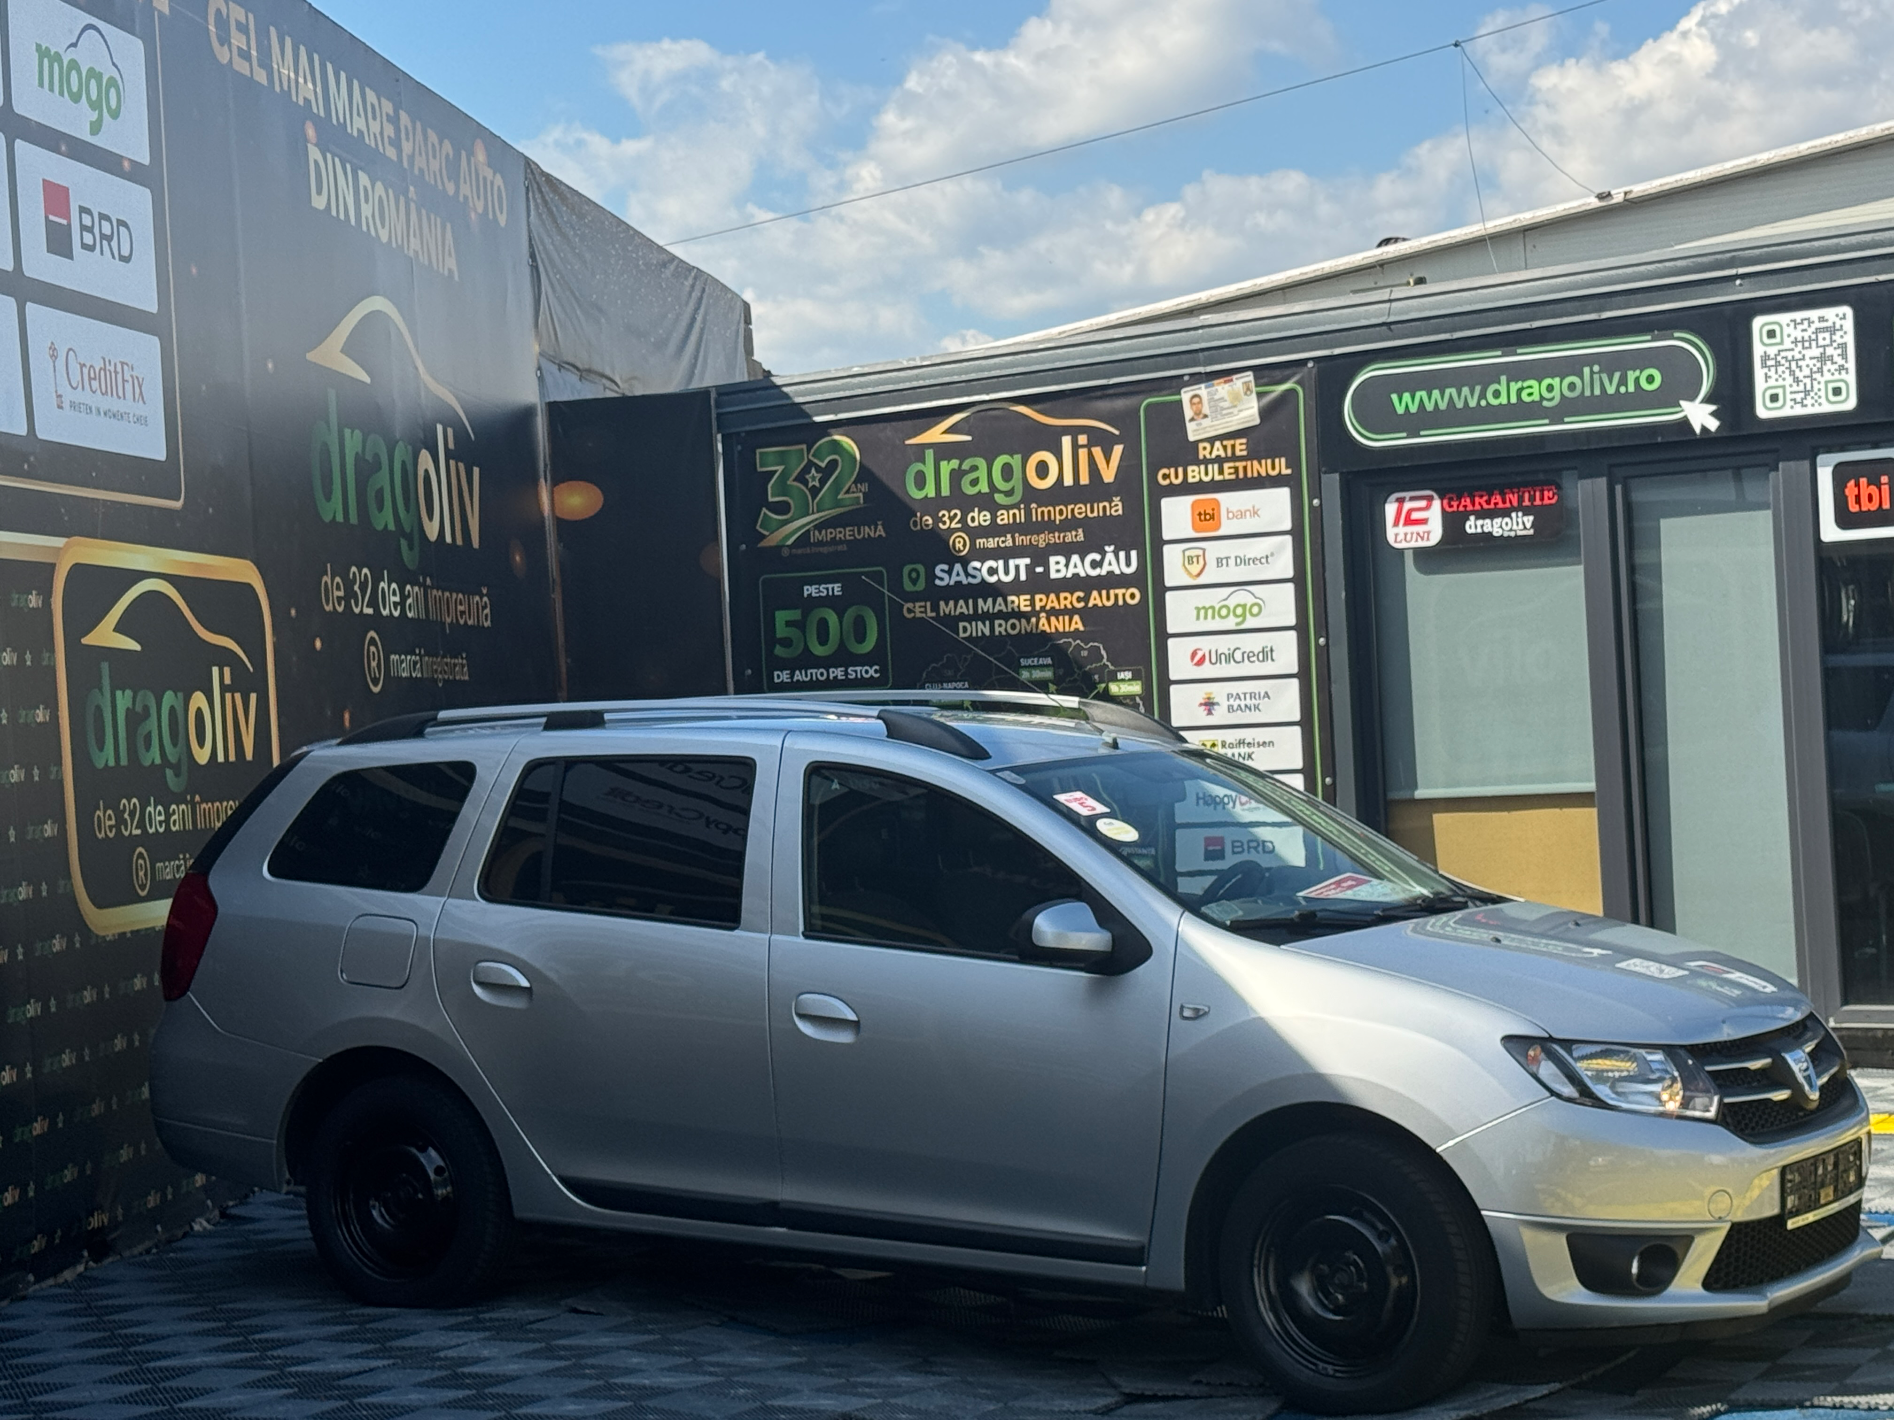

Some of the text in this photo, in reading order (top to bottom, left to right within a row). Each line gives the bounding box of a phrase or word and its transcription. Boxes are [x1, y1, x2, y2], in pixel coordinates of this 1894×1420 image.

[35, 42, 122, 136] mogo
[207, 0, 507, 227] CEL MAI MARE PARC AUTO
[307, 143, 459, 281] DIN ROMÂNIA
[78, 204, 133, 264] BRD
[65, 347, 146, 405] CreditFix
[1390, 364, 1662, 415] www.dragoliv.ro
[69, 400, 93, 416] PRIETEN
[95, 406, 102, 417] IN
[103, 408, 131, 424] MOMENTE
[1198, 438, 1248, 460] RATE
[311, 387, 480, 570] dragoliv
[905, 434, 1124, 505] dragoliv
[1157, 457, 1292, 485] CU BULETINUL
[850, 482, 868, 494] ANI
[1844, 474, 1891, 513] tbi
[910, 496, 1123, 531] de 32 de ani împreună
[1197, 505, 1261, 522] tbi bank
[1391, 485, 1559, 528] 12 GARANTIE
[810, 520, 886, 543] ÎMPREUNĂ
[1394, 530, 1432, 544] LUNI
[1465, 511, 1535, 537] dragoliv
[975, 534, 1013, 549] marcă
[1014, 527, 1085, 548] înregistrată
[934, 557, 1031, 587] SASCUT
[1049, 545, 1138, 580] BACĂU
[1187, 554, 1202, 566] BT
[1216, 556, 1232, 568] BT
[320, 563, 492, 633] de 32 de ani împreună
[803, 583, 842, 598] PESTE
[903, 587, 1141, 619] CEL MAI MARE PARC AUTO
[958, 613, 1085, 638] DIN ROMÂNIA
[1194, 602, 1263, 627] mogo
[773, 604, 878, 658] 500
[390, 648, 422, 678] marcă
[1020, 657, 1052, 666] SUCEAVA
[1208, 645, 1275, 666] UniCredit
[773, 665, 880, 683] DE AUTO PE STOC
[1226, 691, 1271, 703] PATRIA
[1226, 703, 1262, 714] BANK
[85, 661, 257, 793] dragoliv
[1220, 738, 1275, 750] Raiffeisen
[94, 794, 239, 839] de 32 de ani împre
[1231, 839, 1275, 855] BRD
[155, 853, 186, 882] marcă
